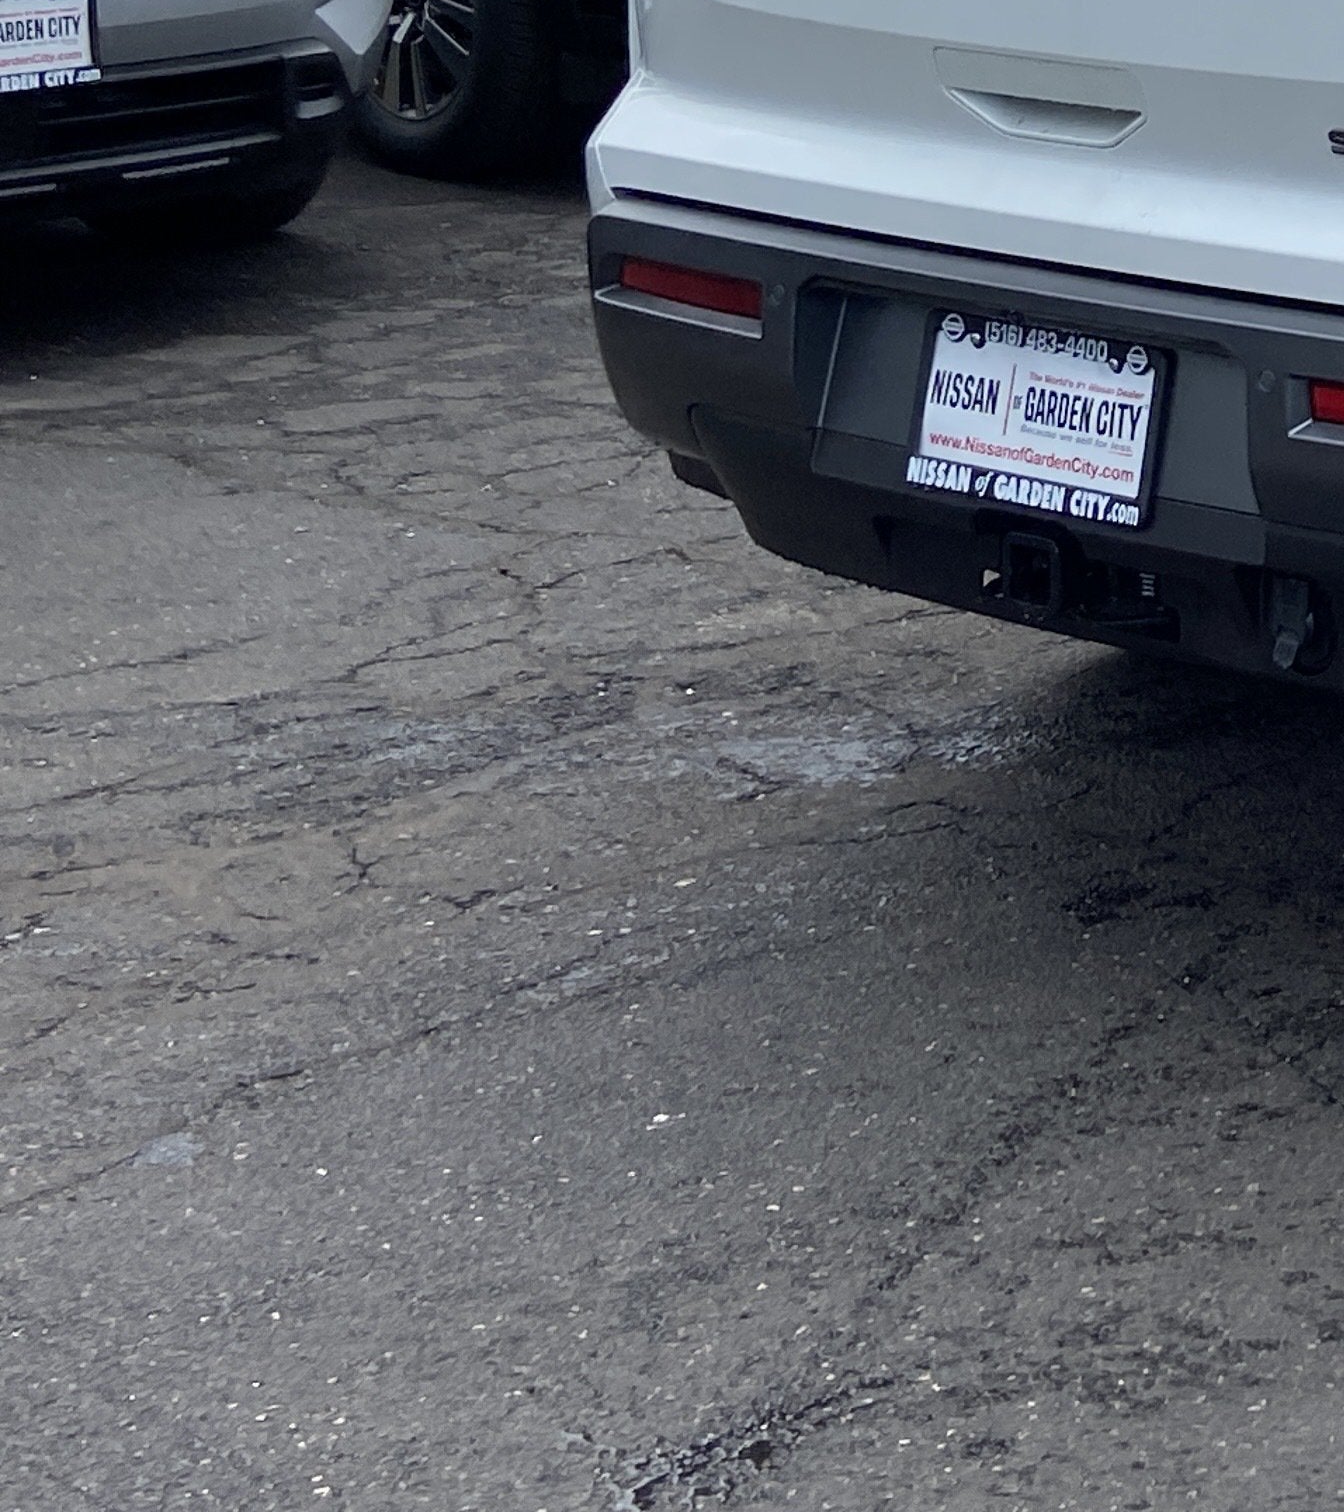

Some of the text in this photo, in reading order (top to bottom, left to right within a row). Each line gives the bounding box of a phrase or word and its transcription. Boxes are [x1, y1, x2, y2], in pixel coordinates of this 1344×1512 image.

[0, 18, 43, 43] ARDEN
[48, 15, 81, 38] CITY
[0, 73, 40, 93] RDEN
[985, 320, 1109, 363] (516) 483-4400
[930, 369, 1001, 416] NISSAN
[1024, 386, 1094, 434] GARDEN
[1096, 399, 1142, 442] CITY
[1116, 388, 1145, 400] Dealer
[929, 431, 1135, 483] www.NissanofGardenCity.com
[906, 456, 1139, 527] NISSAN of GARDEN CITY.com
